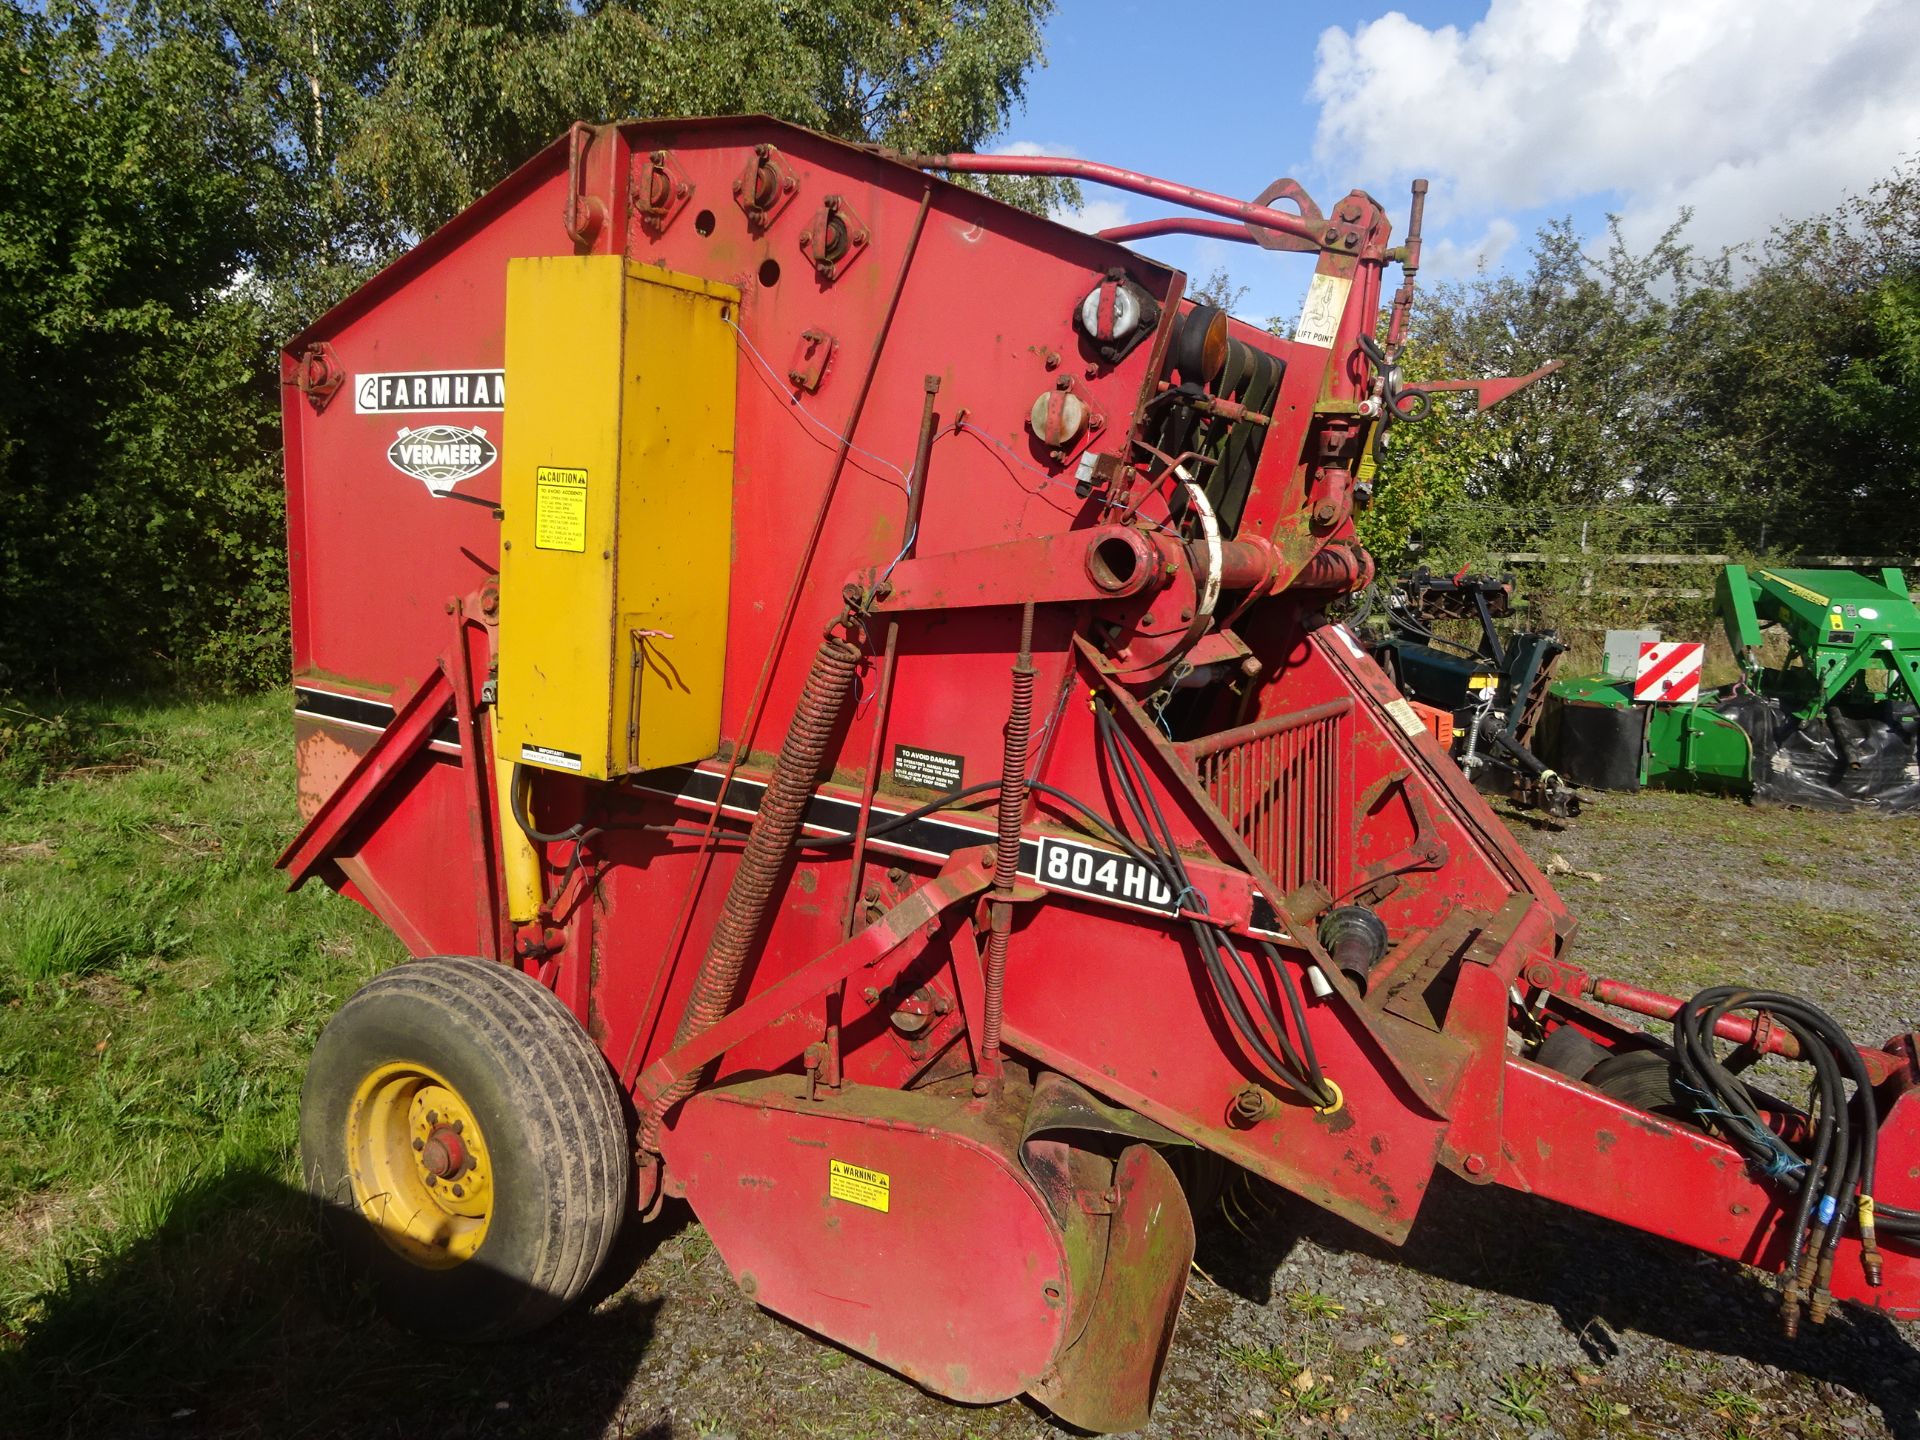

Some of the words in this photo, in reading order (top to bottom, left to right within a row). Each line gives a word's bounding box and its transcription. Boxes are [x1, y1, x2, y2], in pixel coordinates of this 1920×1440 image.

[1298, 329, 1311, 339] LIFT
[1313, 332, 1333, 343] POINT
[400, 444, 482, 465] VERMEER
[548, 472, 578, 484] CAUTION
[911, 752, 929, 760] AVOID
[930, 756, 956, 766] DAMAGE
[1048, 846, 1171, 904] 804HD
[844, 1166, 876, 1182] WARNING
